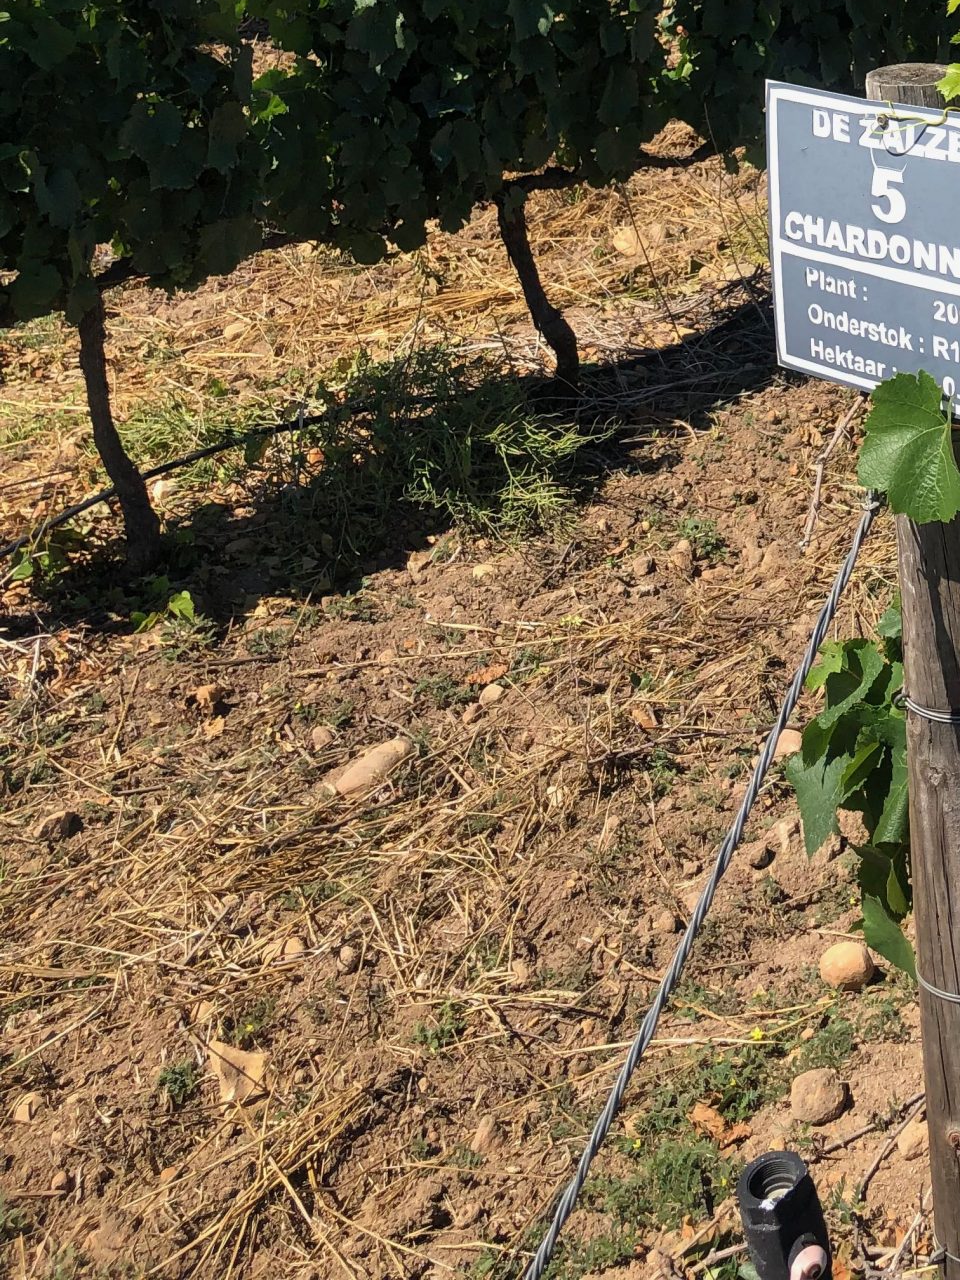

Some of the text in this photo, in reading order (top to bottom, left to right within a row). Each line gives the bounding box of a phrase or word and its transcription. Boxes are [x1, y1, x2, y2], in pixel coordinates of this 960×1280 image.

[812, 109, 851, 144] DE
[871, 166, 907, 224] 5
[806, 267, 857, 299] Plant
[807, 304, 913, 352] Onderstok
[810, 338, 886, 378] Hektaar
